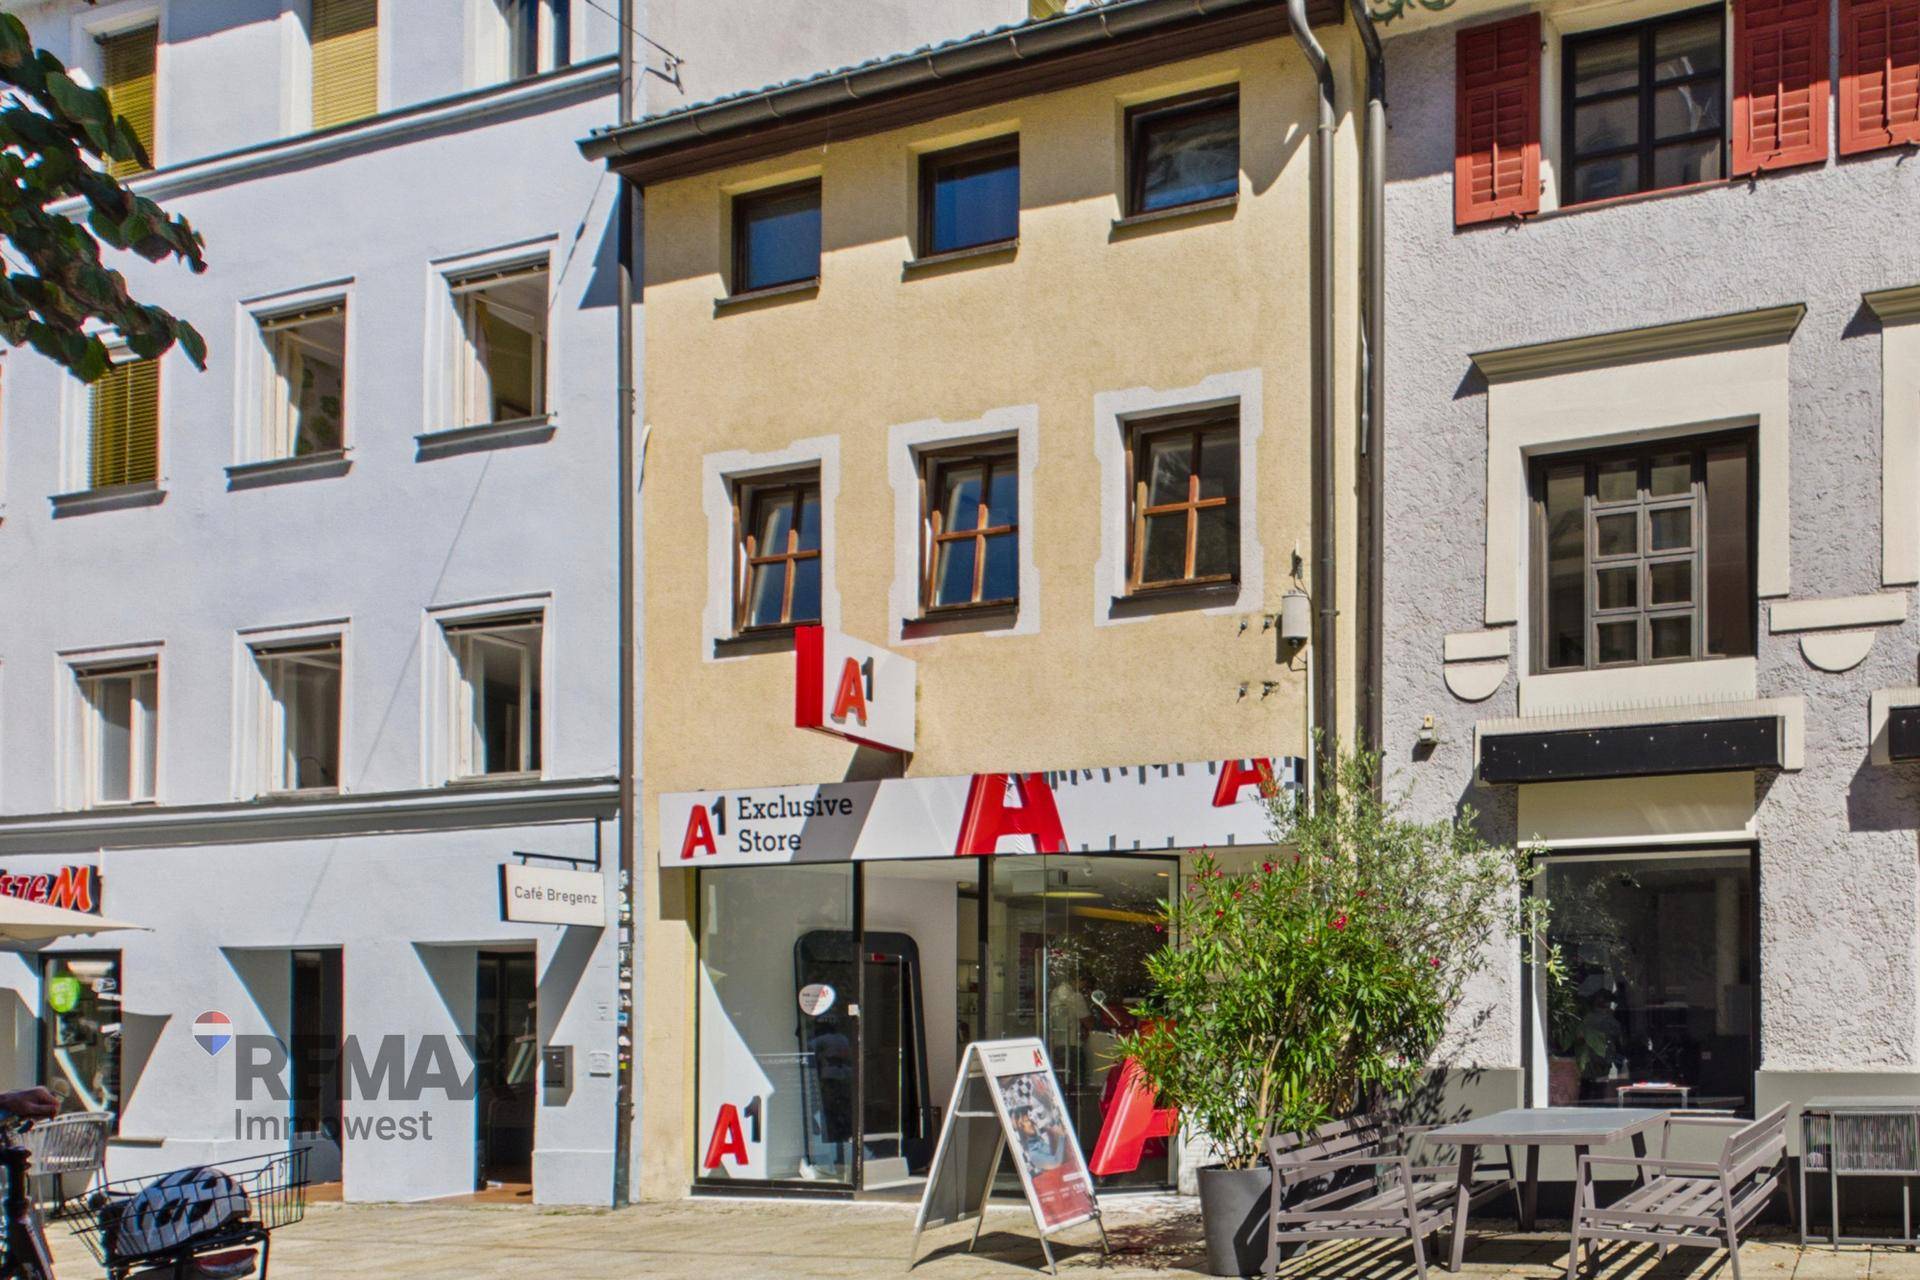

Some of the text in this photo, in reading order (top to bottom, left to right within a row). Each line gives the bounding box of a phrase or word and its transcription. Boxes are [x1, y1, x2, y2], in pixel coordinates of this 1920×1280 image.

[831, 656, 873, 727] A1
[680, 794, 853, 860] A1 Exclusive
[738, 829, 801, 852] Store
[514, 886, 597, 905] Café Bregenz
[704, 1095, 761, 1169] A1
